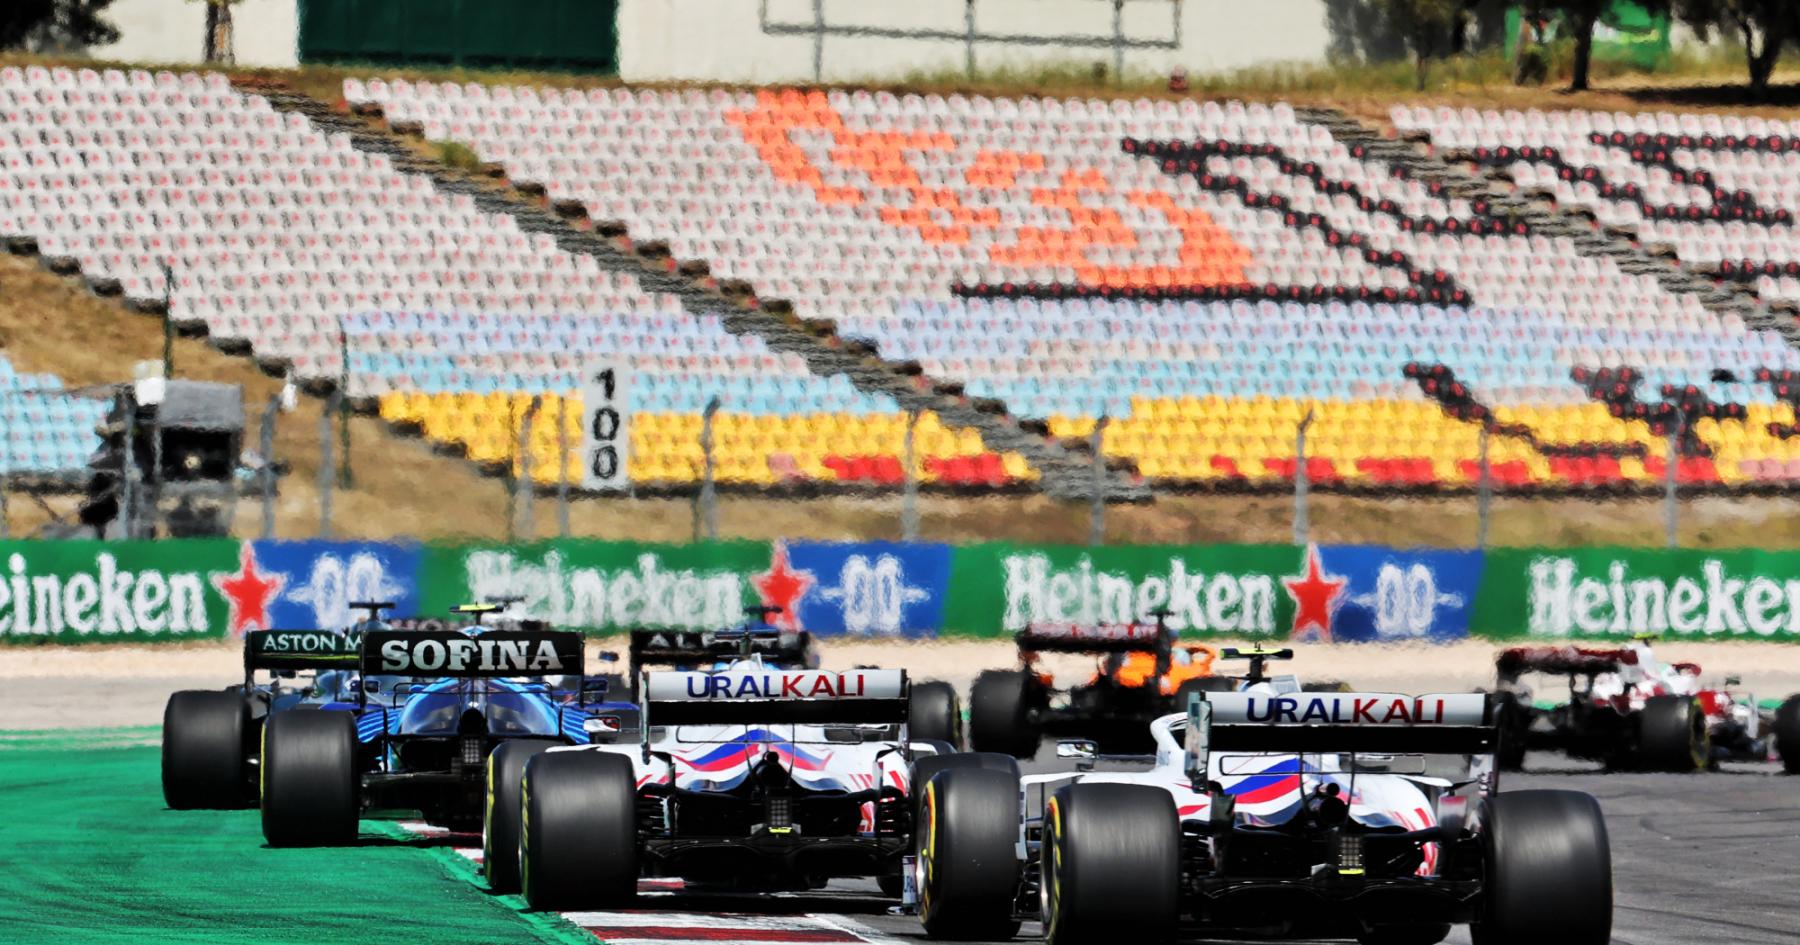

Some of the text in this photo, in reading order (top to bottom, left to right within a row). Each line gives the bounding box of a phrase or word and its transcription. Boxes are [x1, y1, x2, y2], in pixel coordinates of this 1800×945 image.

[592, 367, 620, 479] 100
[466, 549, 743, 628] Heineken
[1002, 553, 1276, 634] Heineken
[263, 633, 336, 651] ASTON
[381, 639, 563, 671] SOFINA
[687, 674, 864, 698] URALKALI
[1246, 698, 1444, 724] URALKALI
